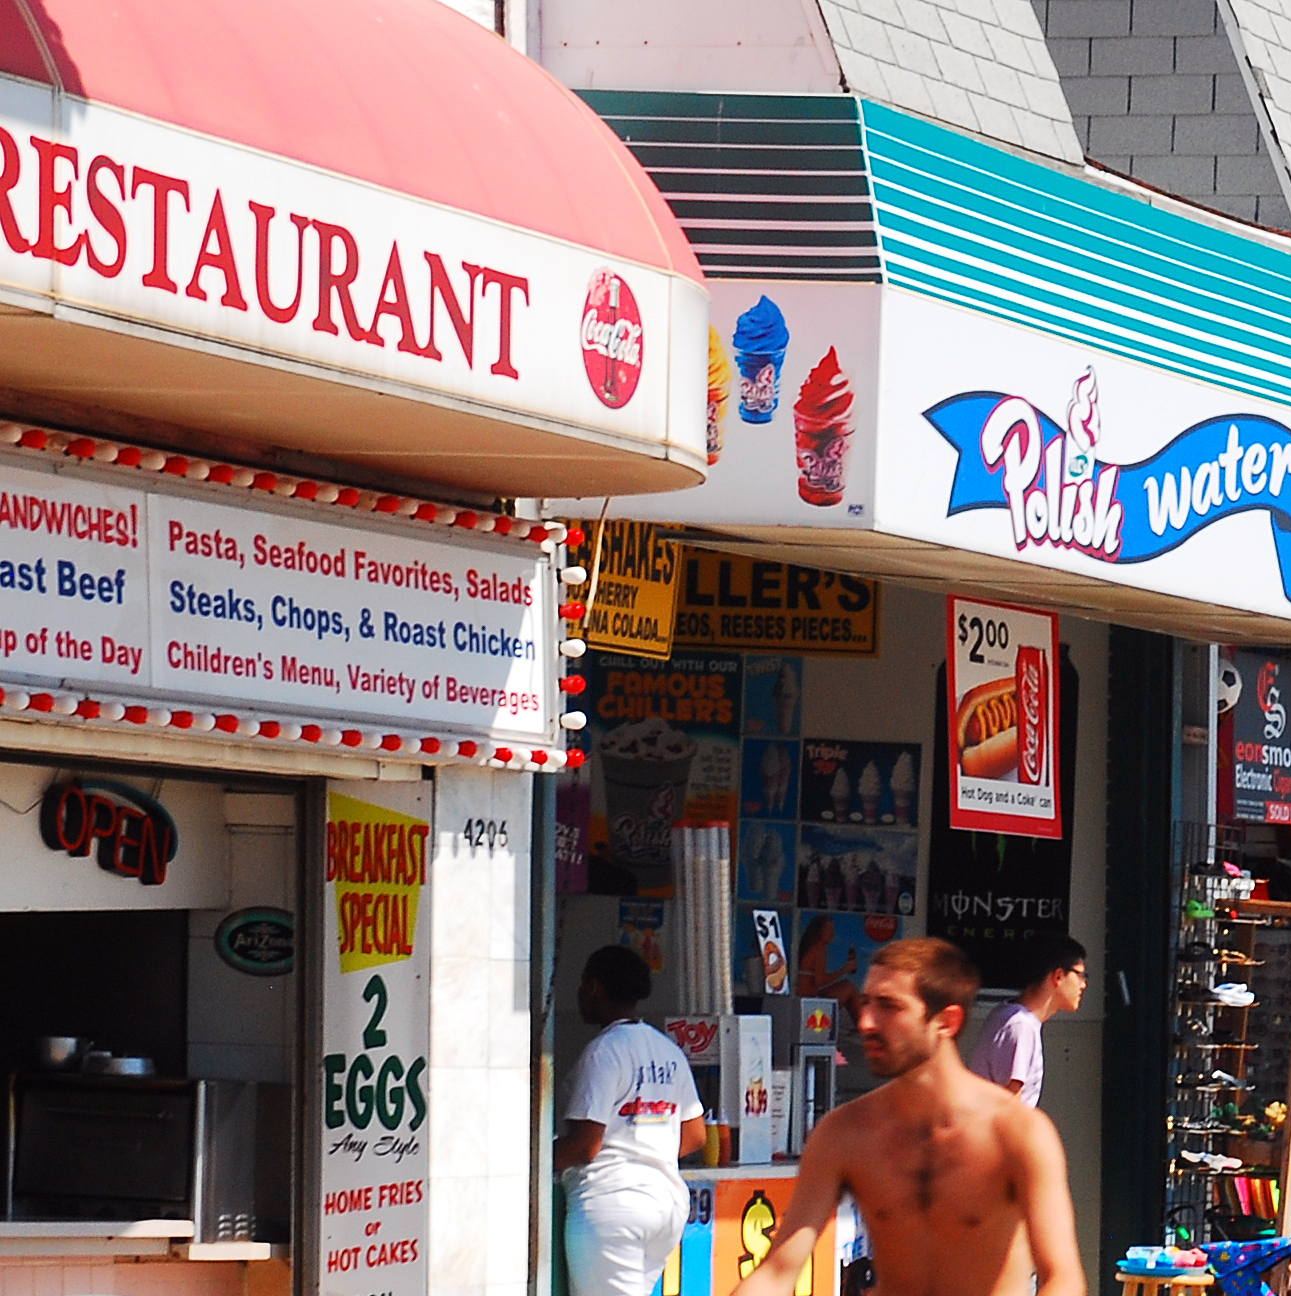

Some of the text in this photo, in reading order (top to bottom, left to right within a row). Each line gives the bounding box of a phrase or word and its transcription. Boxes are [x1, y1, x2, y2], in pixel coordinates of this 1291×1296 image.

[980, 392, 1126, 562] Polish
[57, 559, 126, 605] Beef
[168, 520, 533, 607] Pasta, Seafood Favorites, Salads
[685, 559, 871, 614] LLER'S
[593, 580, 639, 609] HERRY
[169, 580, 536, 661] Steaks, Chops, & Roast Chicken
[720, 613, 787, 641] REESES
[25, 627, 48, 655] of
[56, 631, 93, 661] the
[101, 635, 143, 675] Day
[168, 640, 539, 715] Children's Menu, Variety of Beverages
[606, 672, 726, 699] FAMOUS
[961, 785, 976, 801] Hot
[977, 787, 994, 805] Dog
[995, 790, 1009, 804] and
[1235, 763, 1273, 792] Electronic
[56, 785, 171, 885] OPEN
[1268, 806, 1290, 822] SOLD
[326, 820, 430, 886] BREAKFAST
[340, 892, 413, 956] SPECIAL
[934, 889, 1063, 921] MONSTER
[362, 974, 388, 1050] 2
[324, 1053, 427, 1133] EGGS
[328, 1133, 421, 1163] Any Style
[325, 1179, 424, 1215] HOME FRIES
[365, 1220, 382, 1237] or
[327, 1239, 420, 1274] HOT CAKES
